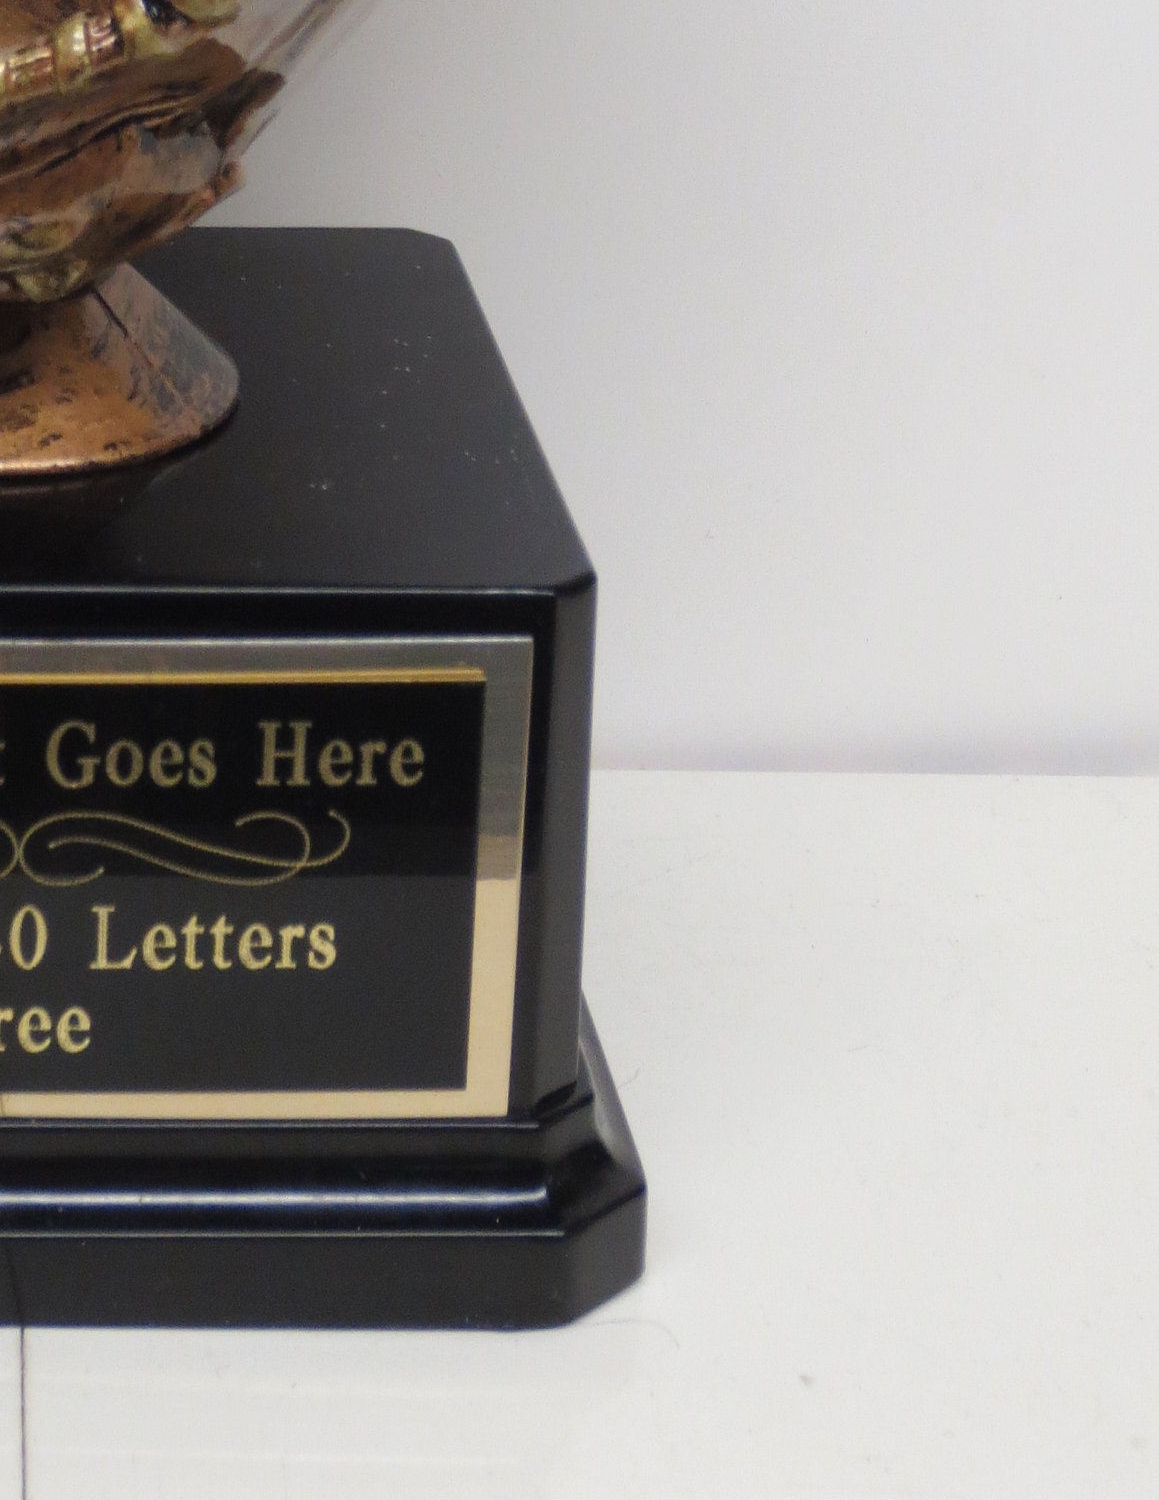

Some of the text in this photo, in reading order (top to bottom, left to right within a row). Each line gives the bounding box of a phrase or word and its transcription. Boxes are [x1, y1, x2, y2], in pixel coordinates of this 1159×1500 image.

[45, 722, 218, 790] Goes
[255, 722, 427, 790] Here
[89, 905, 338, 971] Letters
